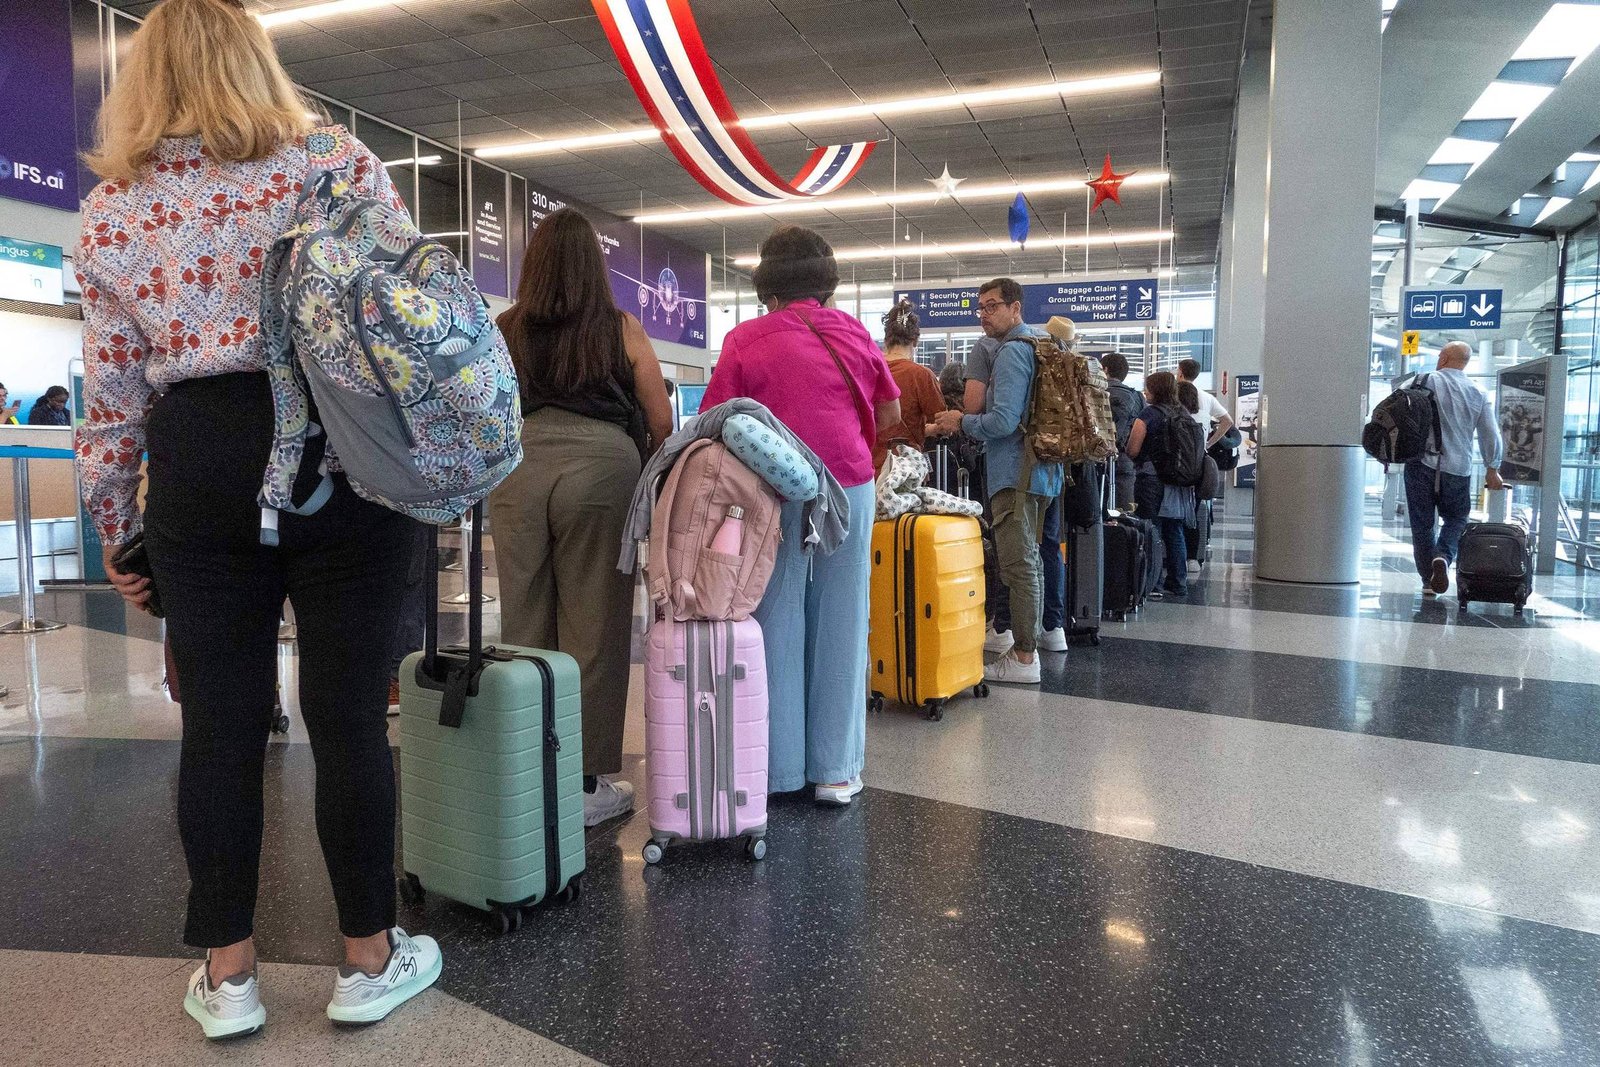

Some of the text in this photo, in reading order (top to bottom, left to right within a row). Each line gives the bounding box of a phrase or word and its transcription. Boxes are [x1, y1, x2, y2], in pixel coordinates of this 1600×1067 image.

[14, 162, 64, 190] IFS.ai
[484, 201, 493, 212] #1
[532, 191, 566, 211] 310 milli
